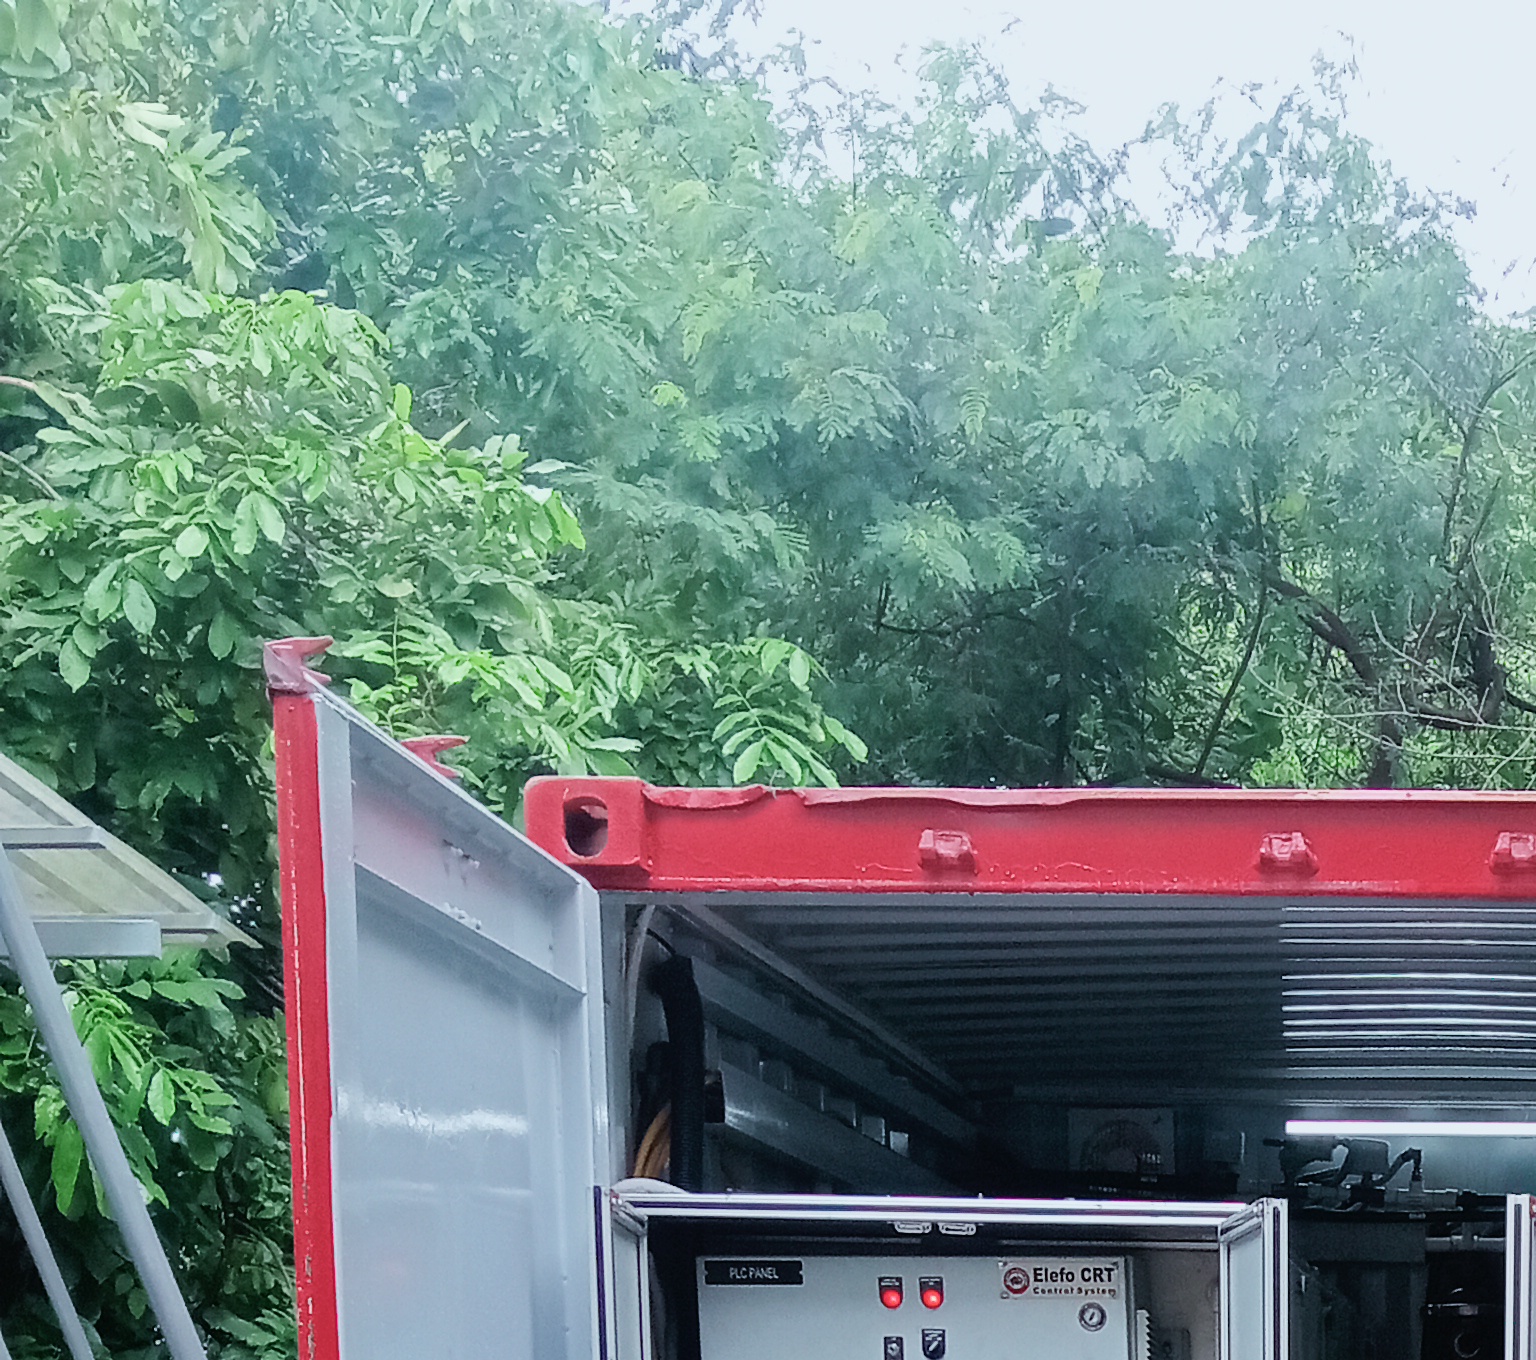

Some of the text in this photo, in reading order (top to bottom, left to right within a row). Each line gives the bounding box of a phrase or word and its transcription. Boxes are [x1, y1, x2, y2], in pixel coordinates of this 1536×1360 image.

[729, 1267, 779, 1279] PLC PANEL
[1033, 1267, 1115, 1283] Elefo CRT
[1033, 1286, 1074, 1295] Control
